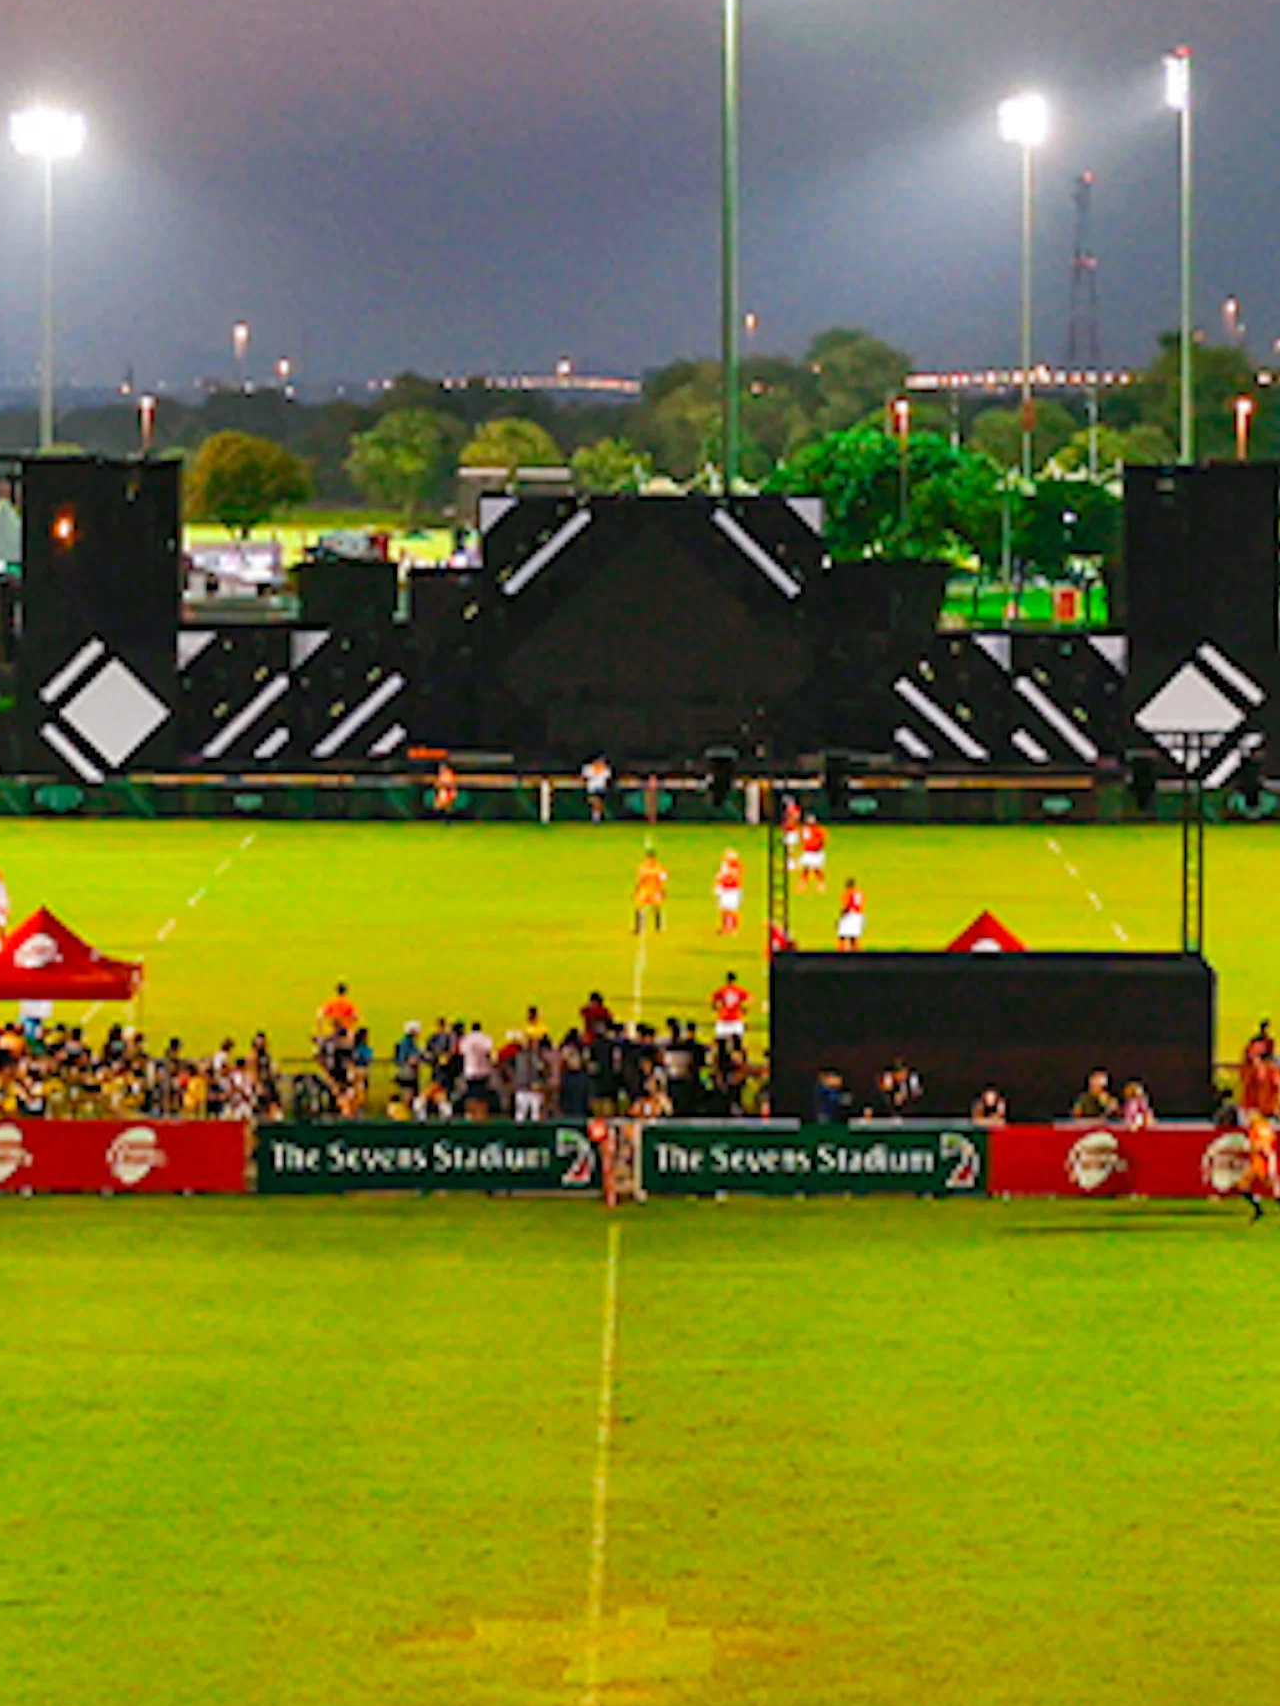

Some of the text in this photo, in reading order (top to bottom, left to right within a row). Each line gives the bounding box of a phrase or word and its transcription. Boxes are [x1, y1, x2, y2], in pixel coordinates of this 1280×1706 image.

[272, 1140, 550, 1172] The Sevens Stadium
[656, 1142, 935, 1173] The Sevens Stadium
